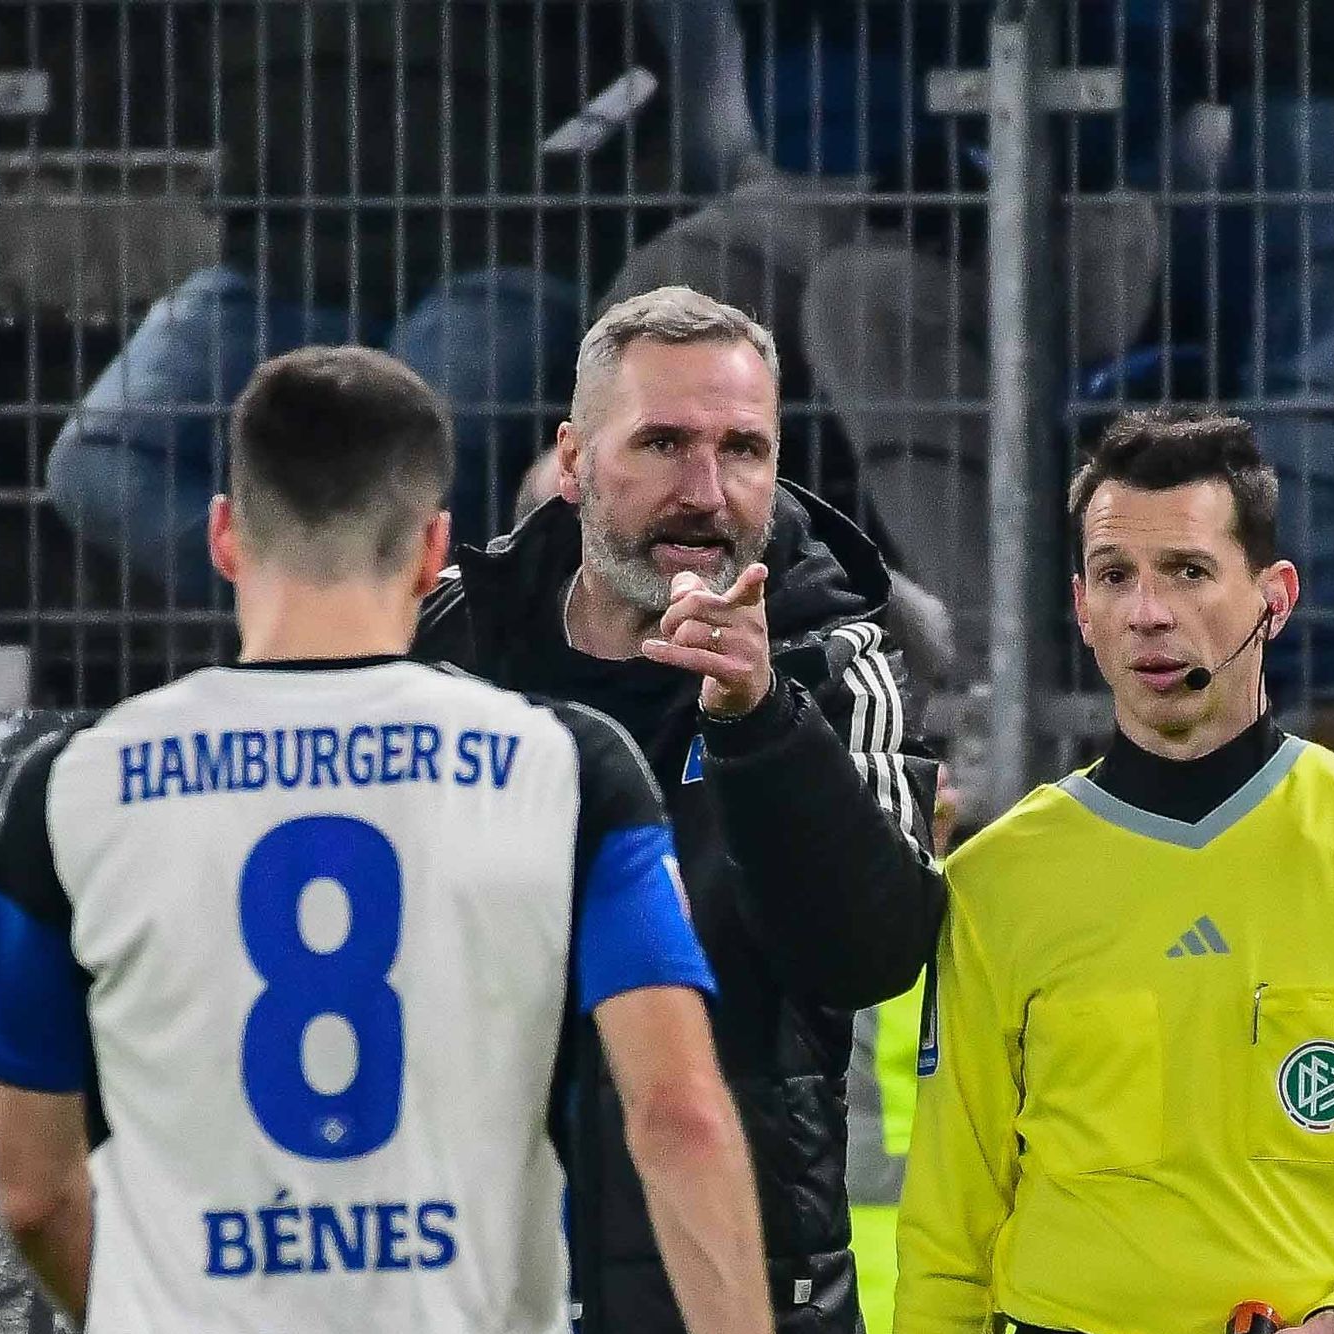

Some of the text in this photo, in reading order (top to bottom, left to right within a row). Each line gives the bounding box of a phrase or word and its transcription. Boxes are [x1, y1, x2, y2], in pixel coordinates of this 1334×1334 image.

[120, 724, 519, 804] HAMBURGER SV
[239, 814, 404, 1161] 8
[204, 1188, 457, 1277] BÉNES
